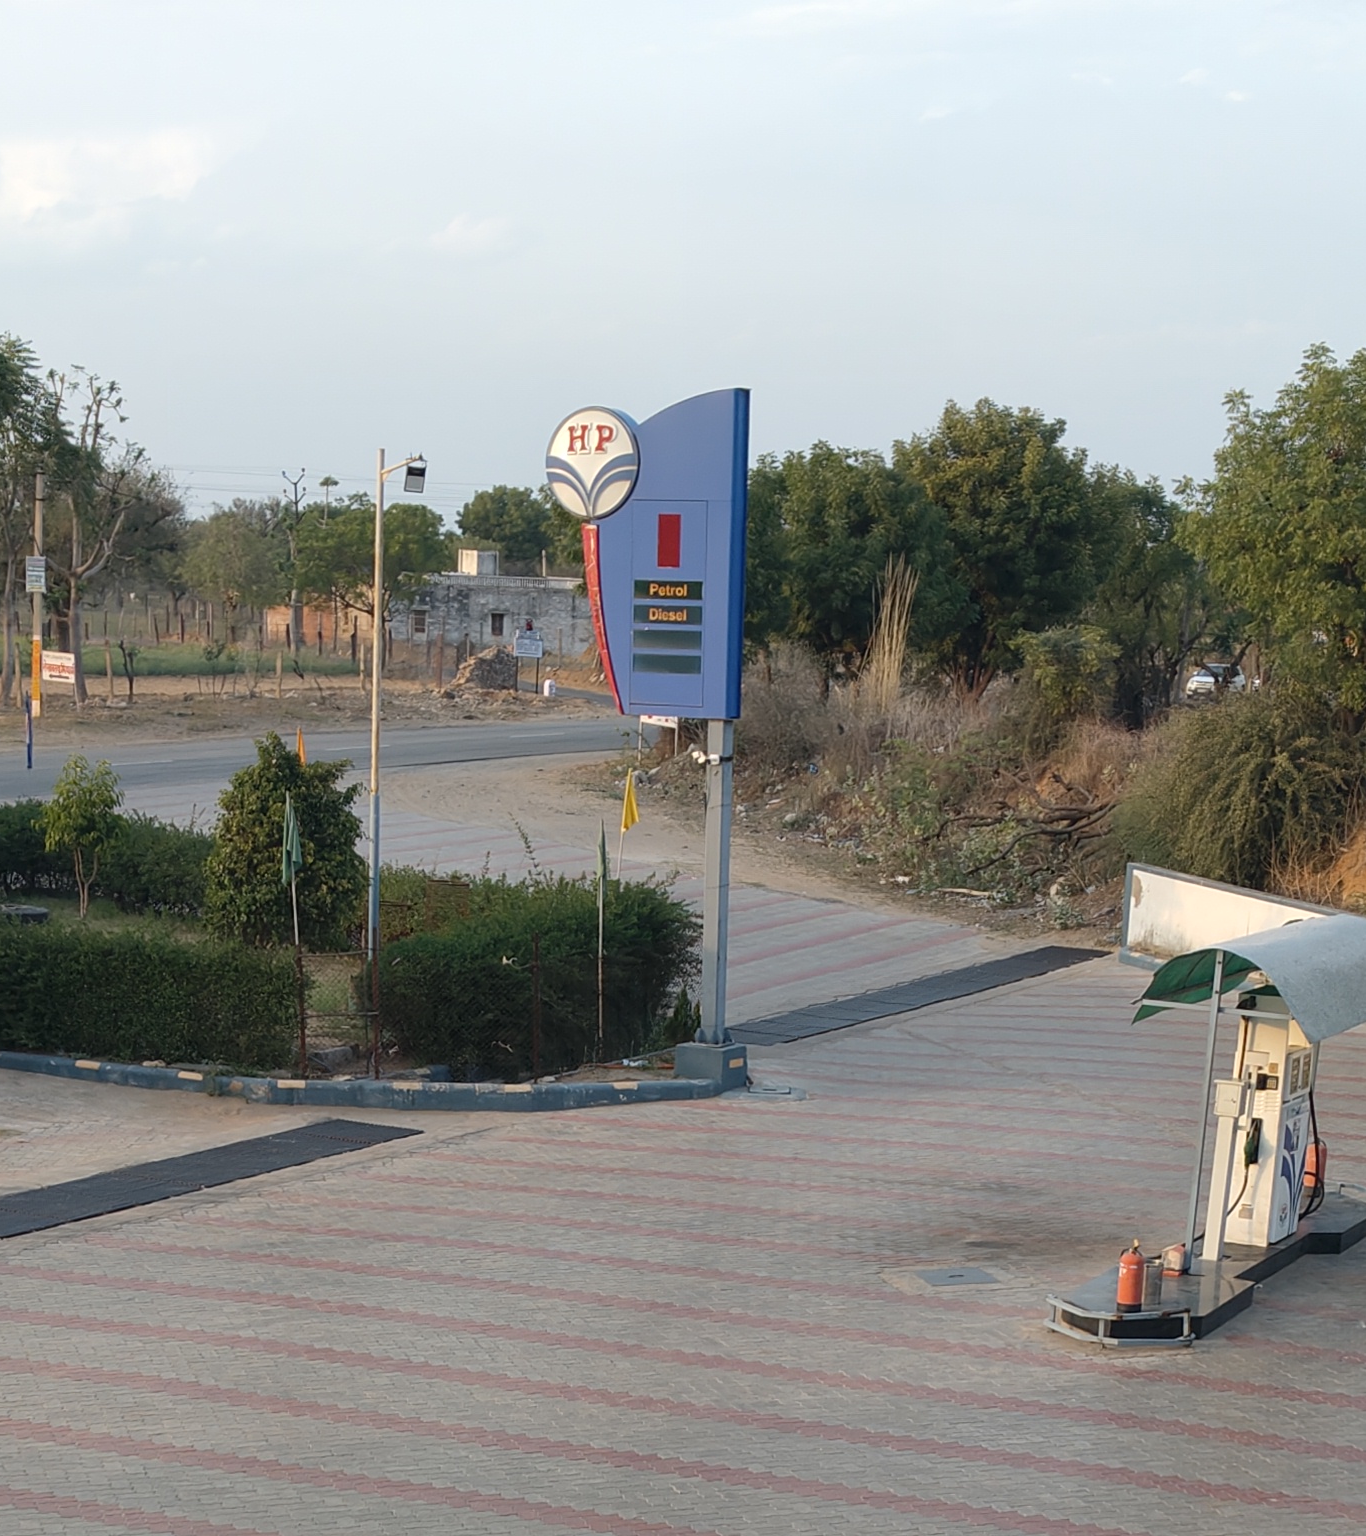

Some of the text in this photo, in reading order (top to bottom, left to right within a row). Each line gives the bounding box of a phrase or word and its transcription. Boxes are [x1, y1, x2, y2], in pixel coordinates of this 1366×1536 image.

[567, 424, 614, 454] HP
[649, 582, 688, 598] Petrol
[648, 607, 688, 622] Diesel
